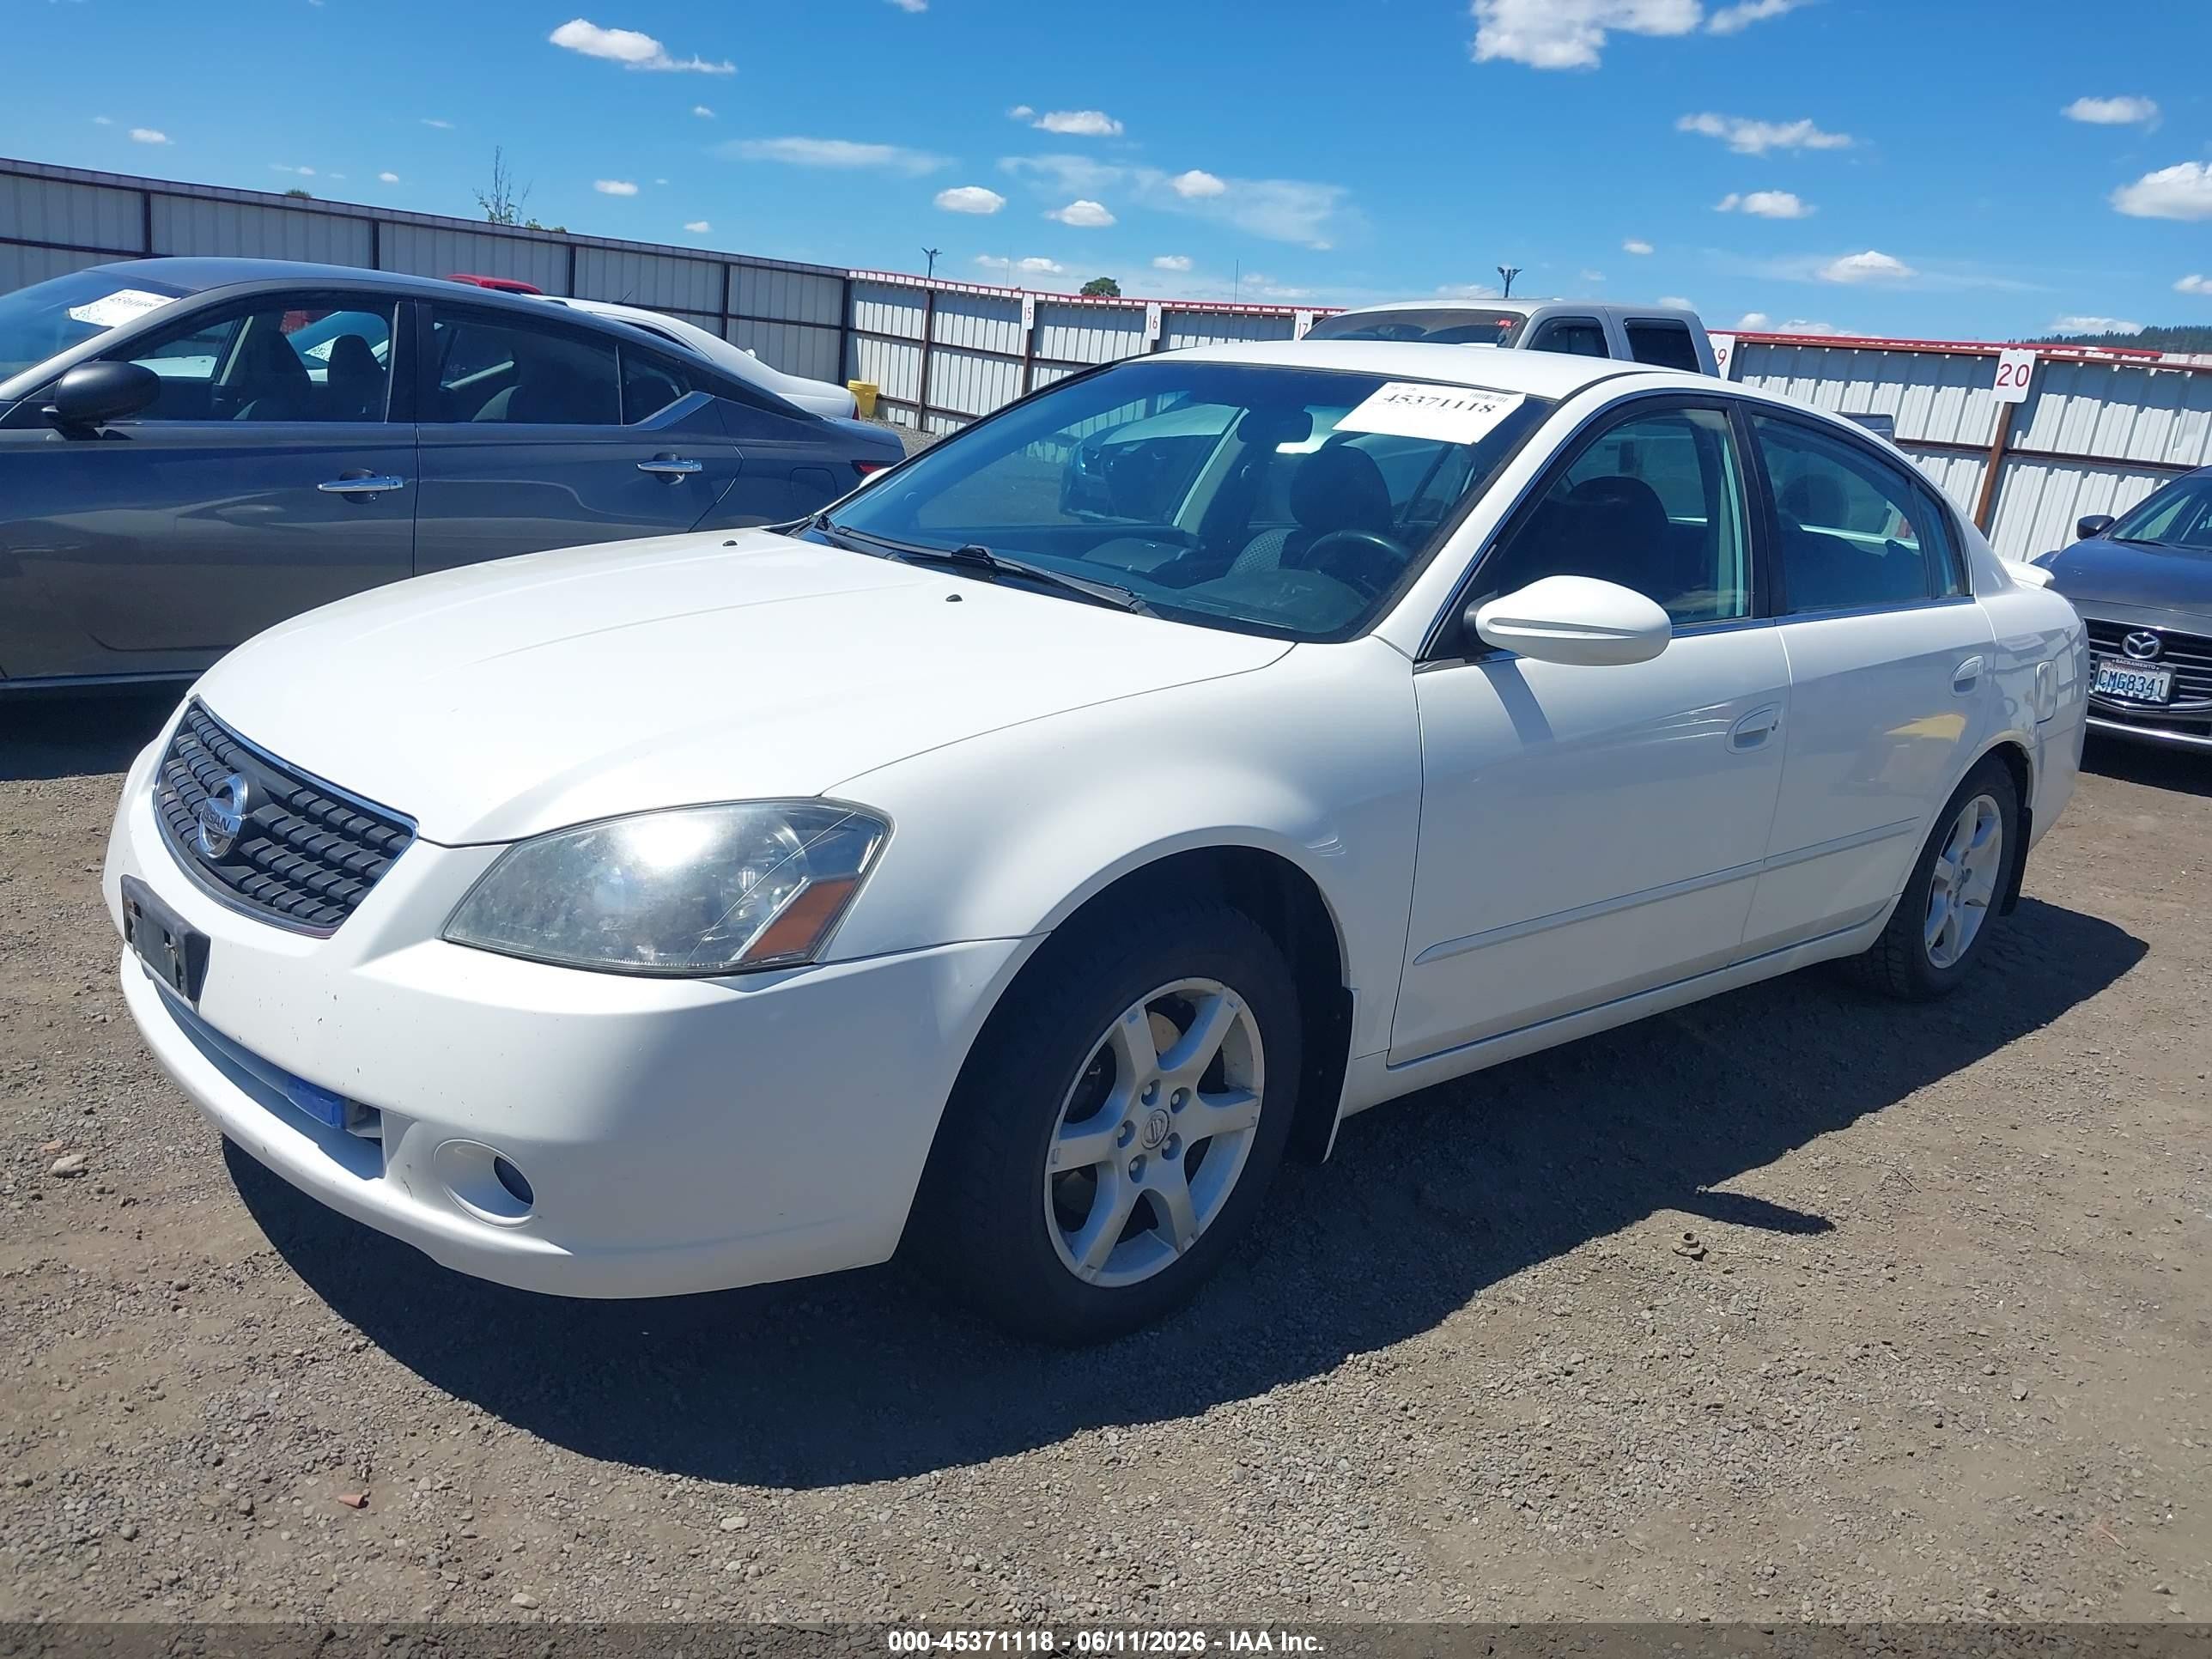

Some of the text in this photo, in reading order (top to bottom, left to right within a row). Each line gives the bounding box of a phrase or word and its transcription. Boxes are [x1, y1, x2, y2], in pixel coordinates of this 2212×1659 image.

[1023, 307, 1032, 321] 15
[1148, 315, 1158, 330] 16
[1297, 322, 1309, 339] 17
[1717, 348, 1728, 367] 9
[1996, 362, 2030, 388] 20
[1382, 393, 1497, 414] 45371118
[2115, 659, 2156, 670] SACRAMENTO
[2098, 668, 2166, 699] CMG8341
